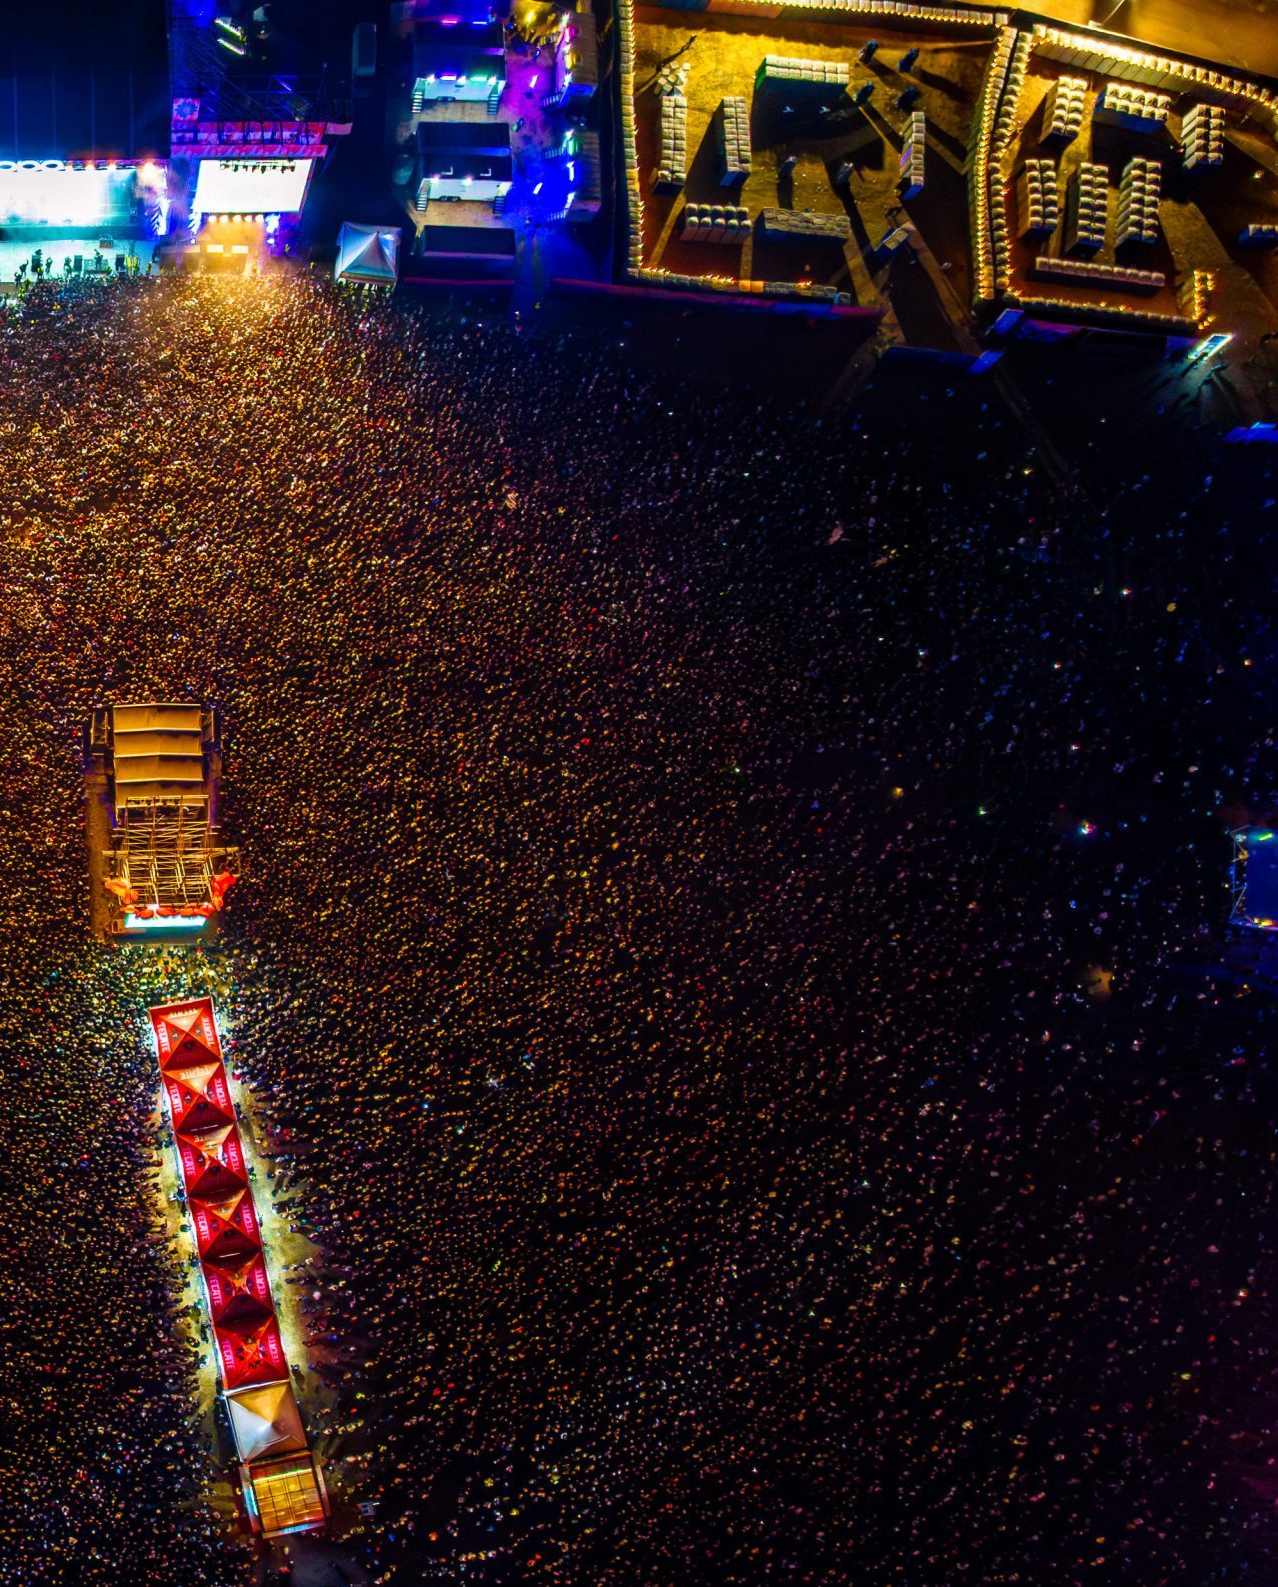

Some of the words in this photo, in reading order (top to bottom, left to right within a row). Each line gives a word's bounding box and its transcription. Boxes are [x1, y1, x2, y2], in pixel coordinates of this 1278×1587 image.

[157, 1021, 171, 1053] TECATE
[202, 1016, 215, 1047] TECATE
[169, 1083, 183, 1114] TECATE
[214, 1078, 227, 1109] TECATE
[183, 1145, 197, 1176] TECATE
[228, 1141, 241, 1172] TECATE
[197, 1210, 210, 1242] TECATE
[242, 1203, 254, 1234] TECATE
[209, 1273, 223, 1306] TECATE
[222, 1339, 236, 1369] TECATE
[268, 1334, 280, 1364] TECATE
